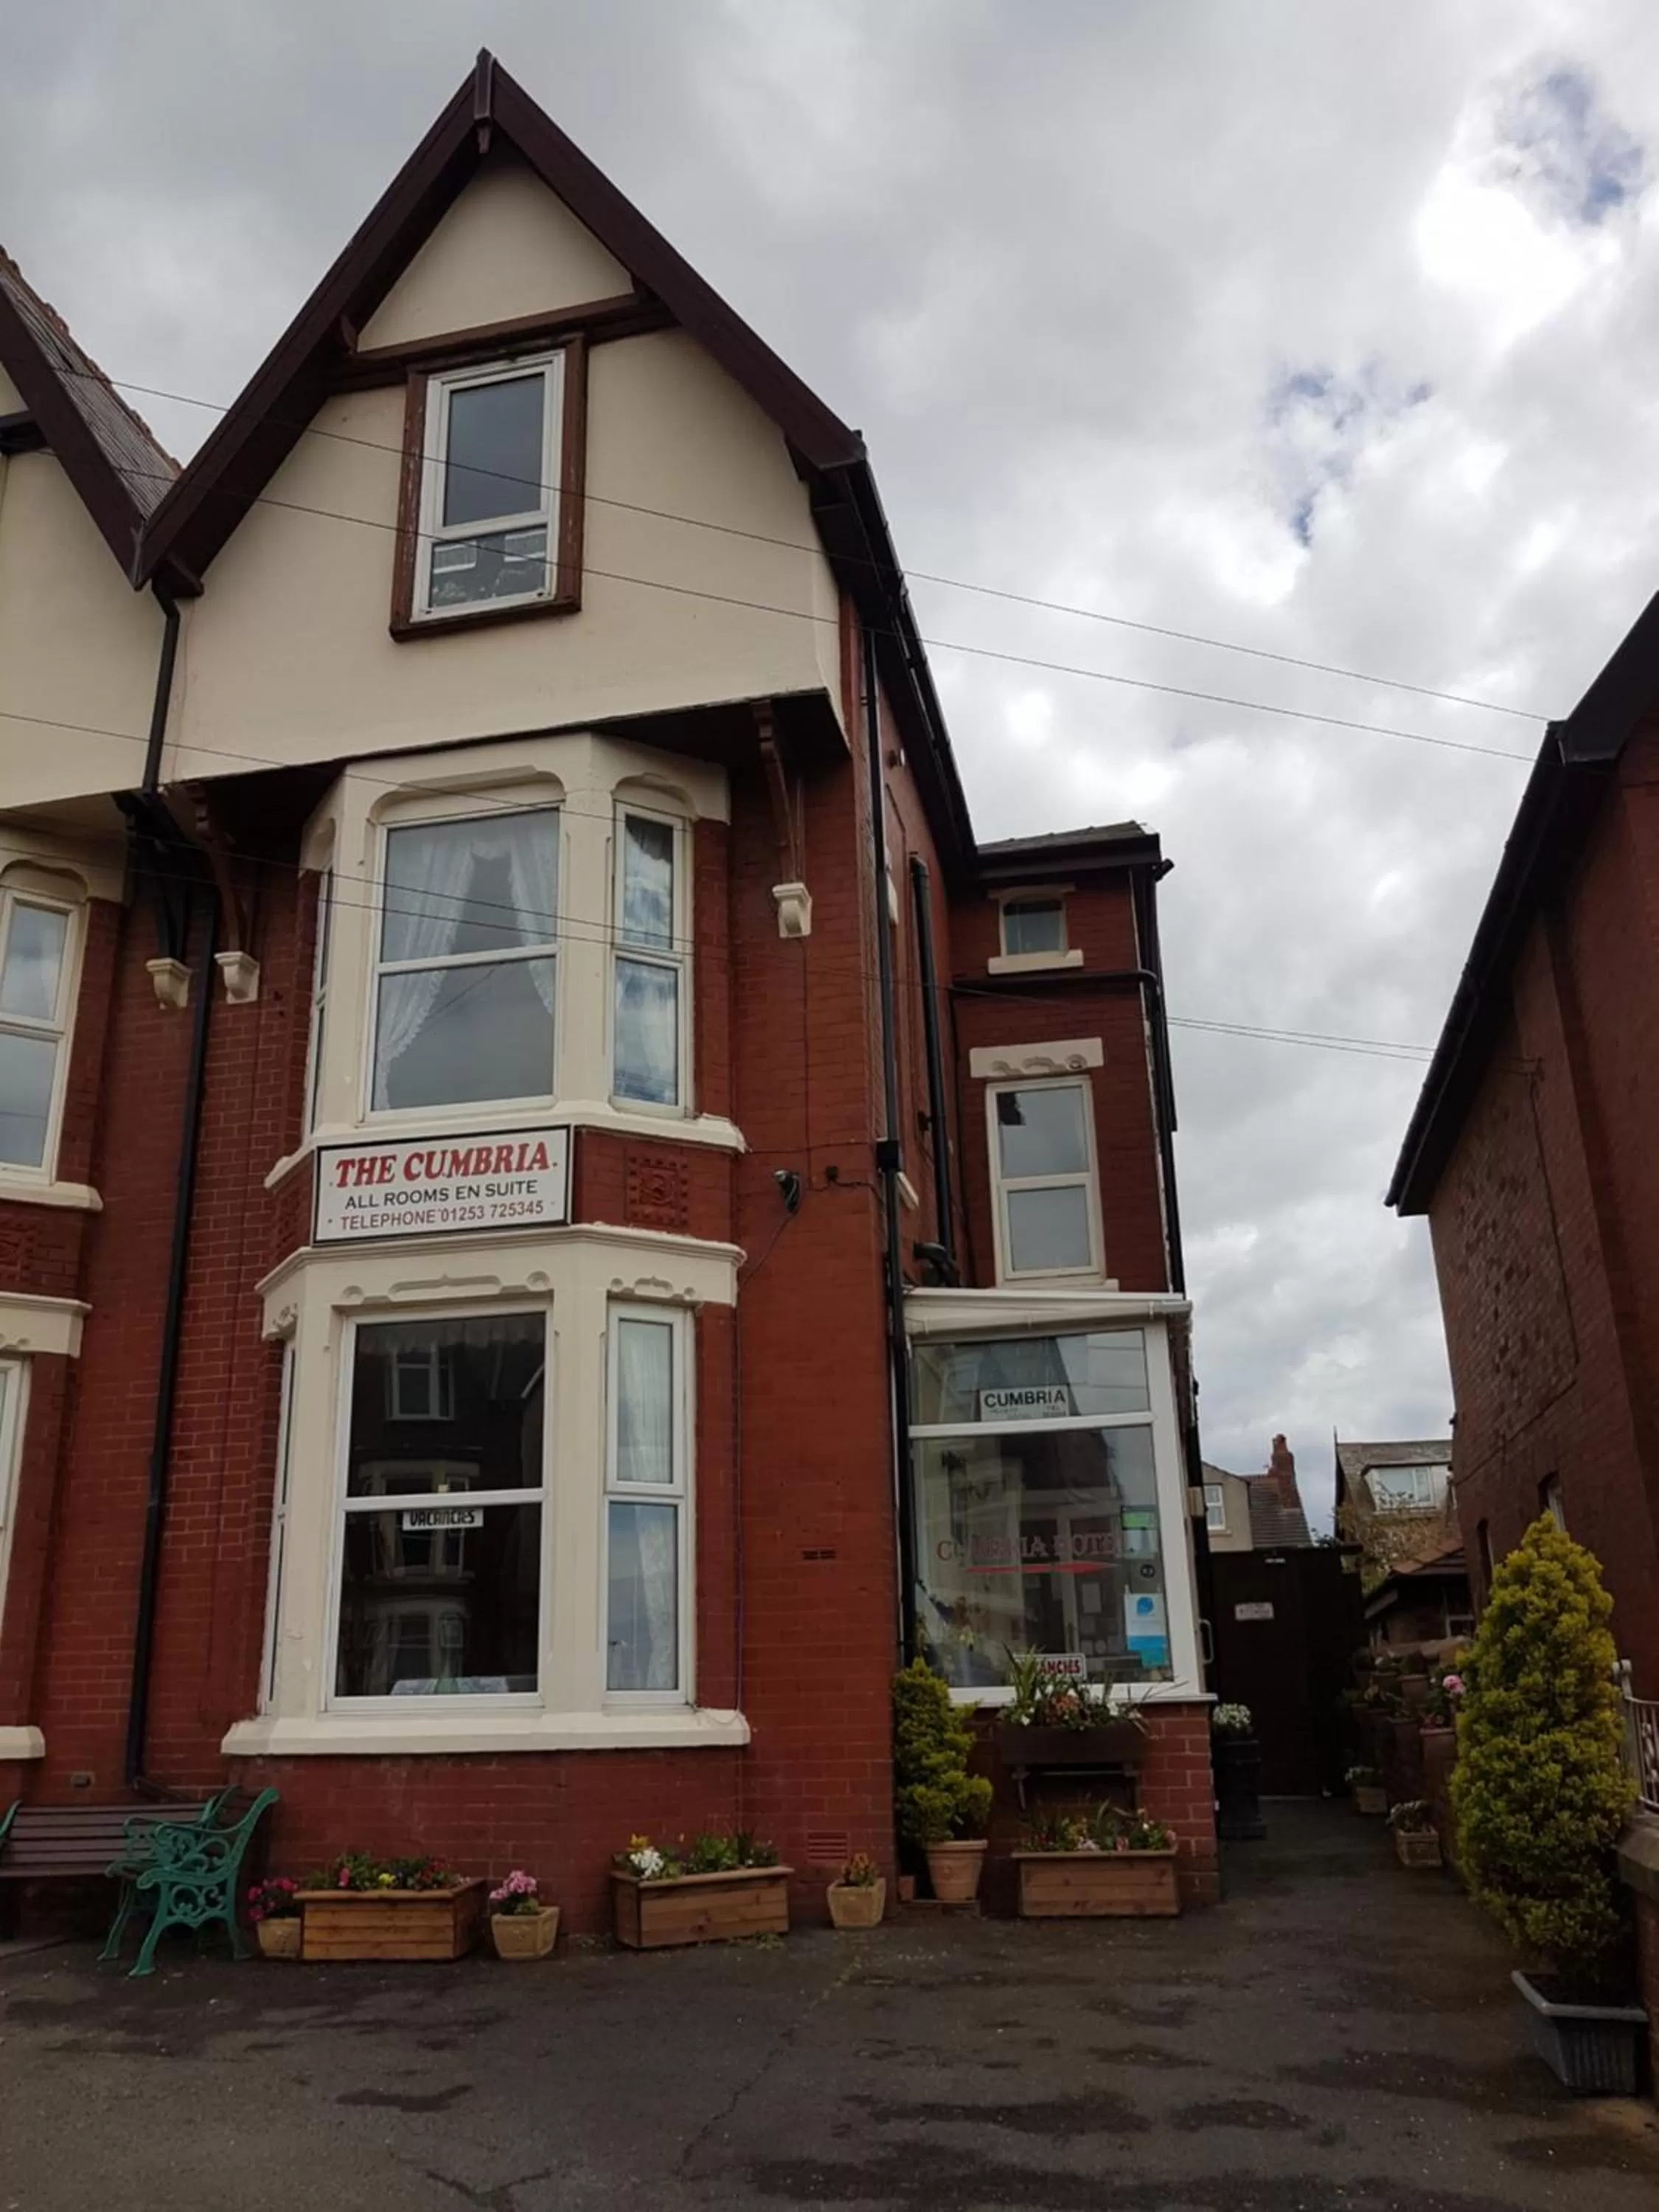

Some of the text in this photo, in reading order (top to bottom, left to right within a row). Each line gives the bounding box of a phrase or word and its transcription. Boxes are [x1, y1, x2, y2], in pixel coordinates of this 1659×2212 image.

[335, 1141, 549, 1188] THE CUMBRIA
[344, 1180, 538, 1210] ALL ROOMS EN SUITE
[341, 1200, 544, 1231] TELEPHONE 01253 725345
[984, 1389, 1066, 1408] CUMBRIA
